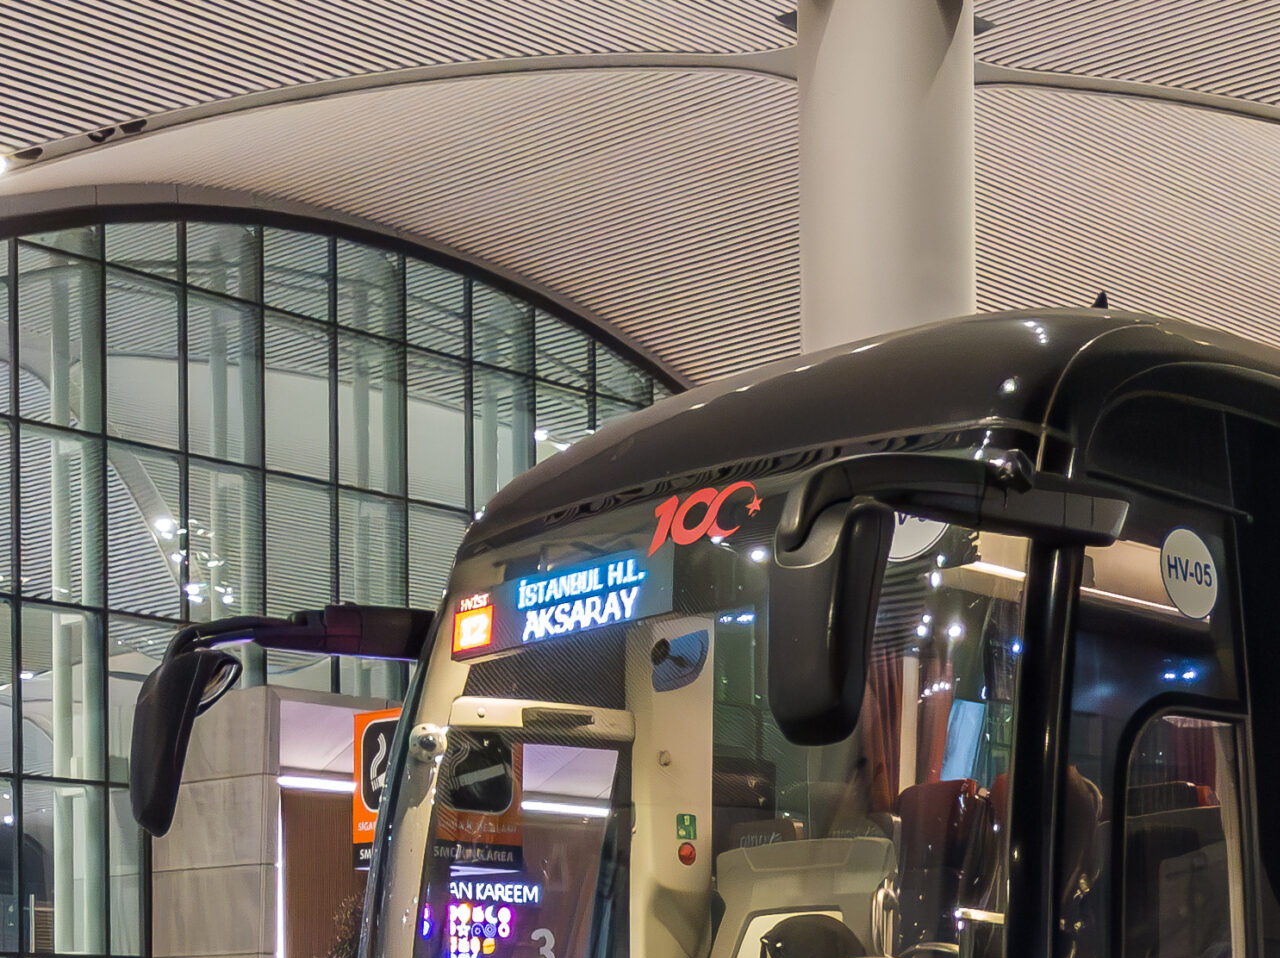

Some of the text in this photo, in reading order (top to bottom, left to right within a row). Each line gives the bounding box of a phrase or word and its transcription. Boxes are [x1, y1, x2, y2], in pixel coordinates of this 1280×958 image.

[517, 558, 646, 609] İSTANBUL H.L.
[1166, 554, 1212, 587] HV-05
[522, 586, 641, 642] AKSARAY
[476, 883, 539, 903] KAREEM
